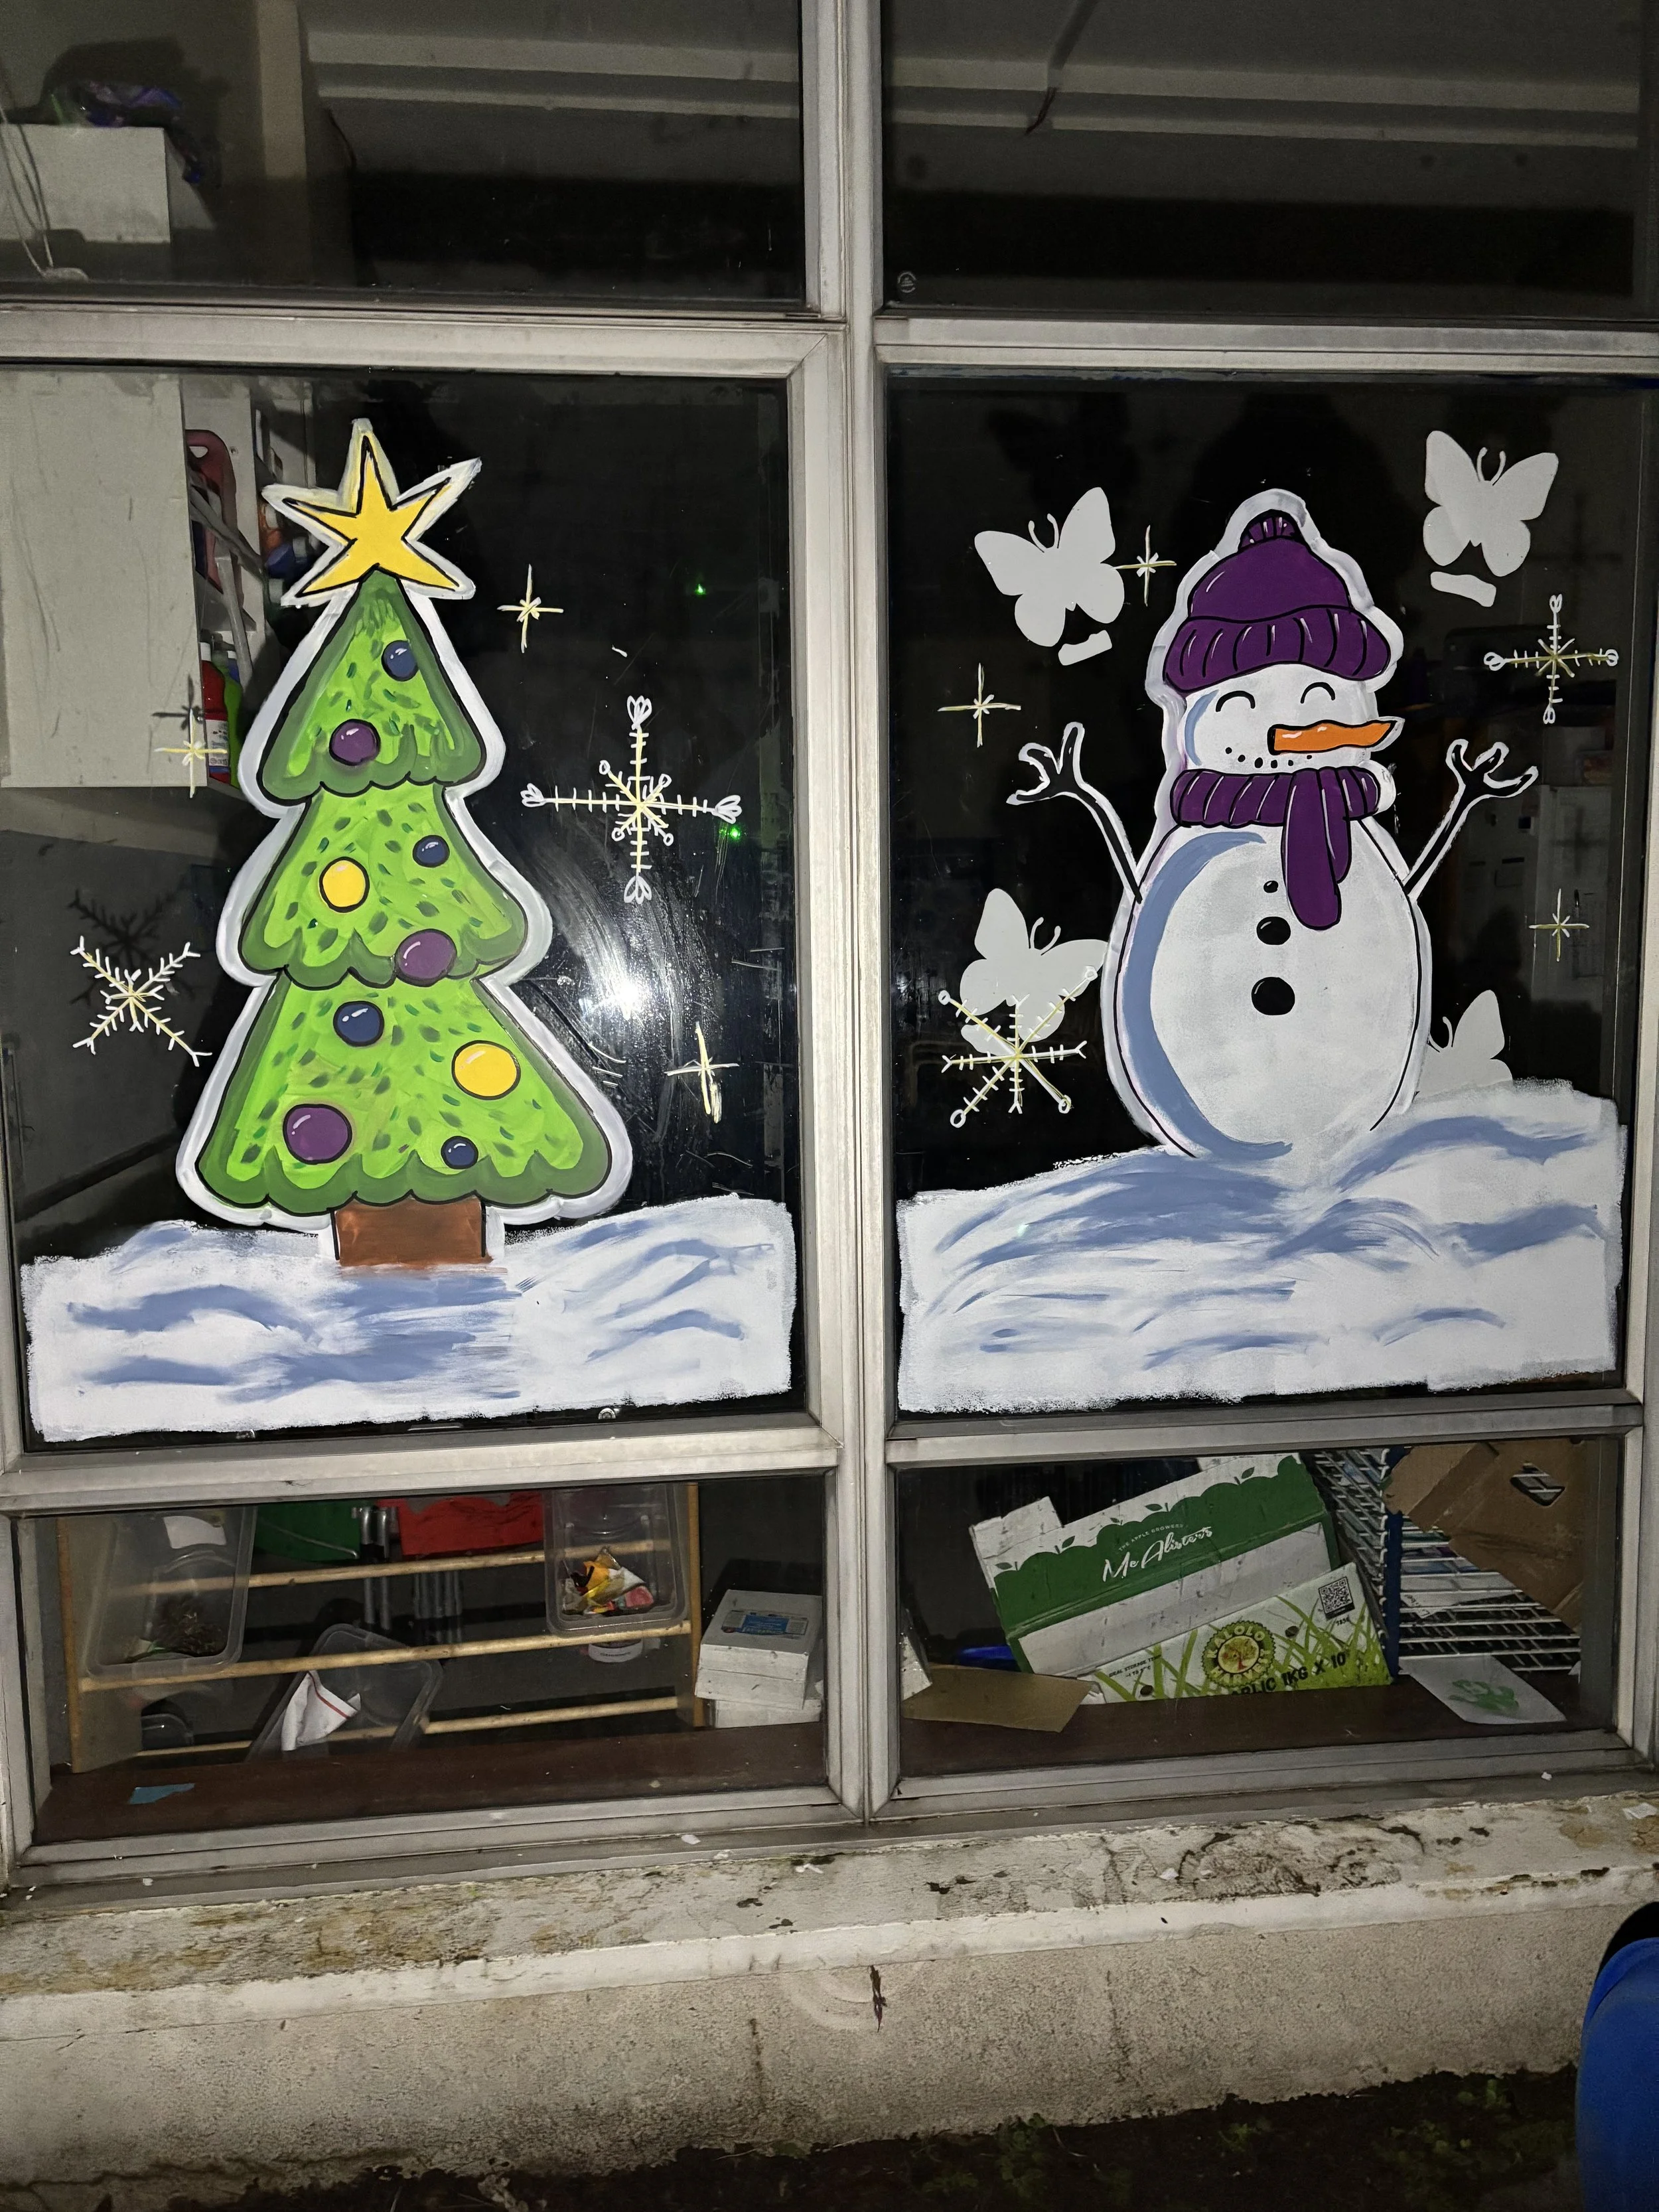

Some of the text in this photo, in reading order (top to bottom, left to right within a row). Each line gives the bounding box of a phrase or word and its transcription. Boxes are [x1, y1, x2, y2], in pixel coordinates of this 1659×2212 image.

[1118, 1524, 1185, 1552] THE APPLE GROWERS
[1206, 1625, 1265, 1659] KALOLO
[1281, 1666, 1309, 1686] 1KG
[1314, 1659, 1326, 1676] X
[1331, 1651, 1346, 1669] 10
